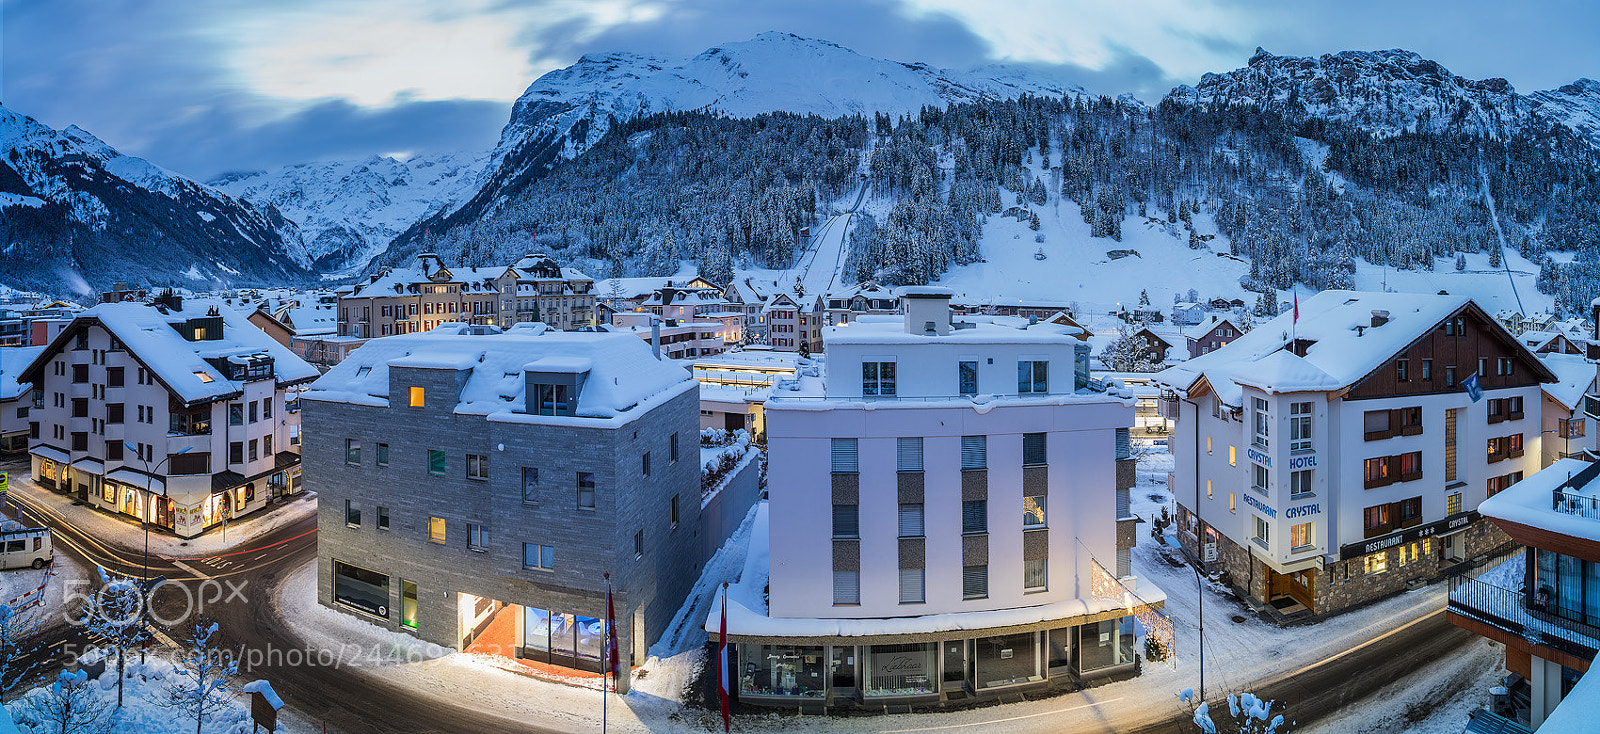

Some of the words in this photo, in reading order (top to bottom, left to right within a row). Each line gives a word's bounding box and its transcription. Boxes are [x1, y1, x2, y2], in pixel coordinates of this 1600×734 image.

[1247, 448, 1273, 468] CRYSTAL
[1289, 456, 1317, 469] HOTEL
[1243, 493, 1277, 519] RESTAURANT
[1285, 503, 1321, 519] CRYSTAL
[1365, 534, 1403, 553] RESTAURANT
[1448, 516, 1469, 529] CRYSTAL
